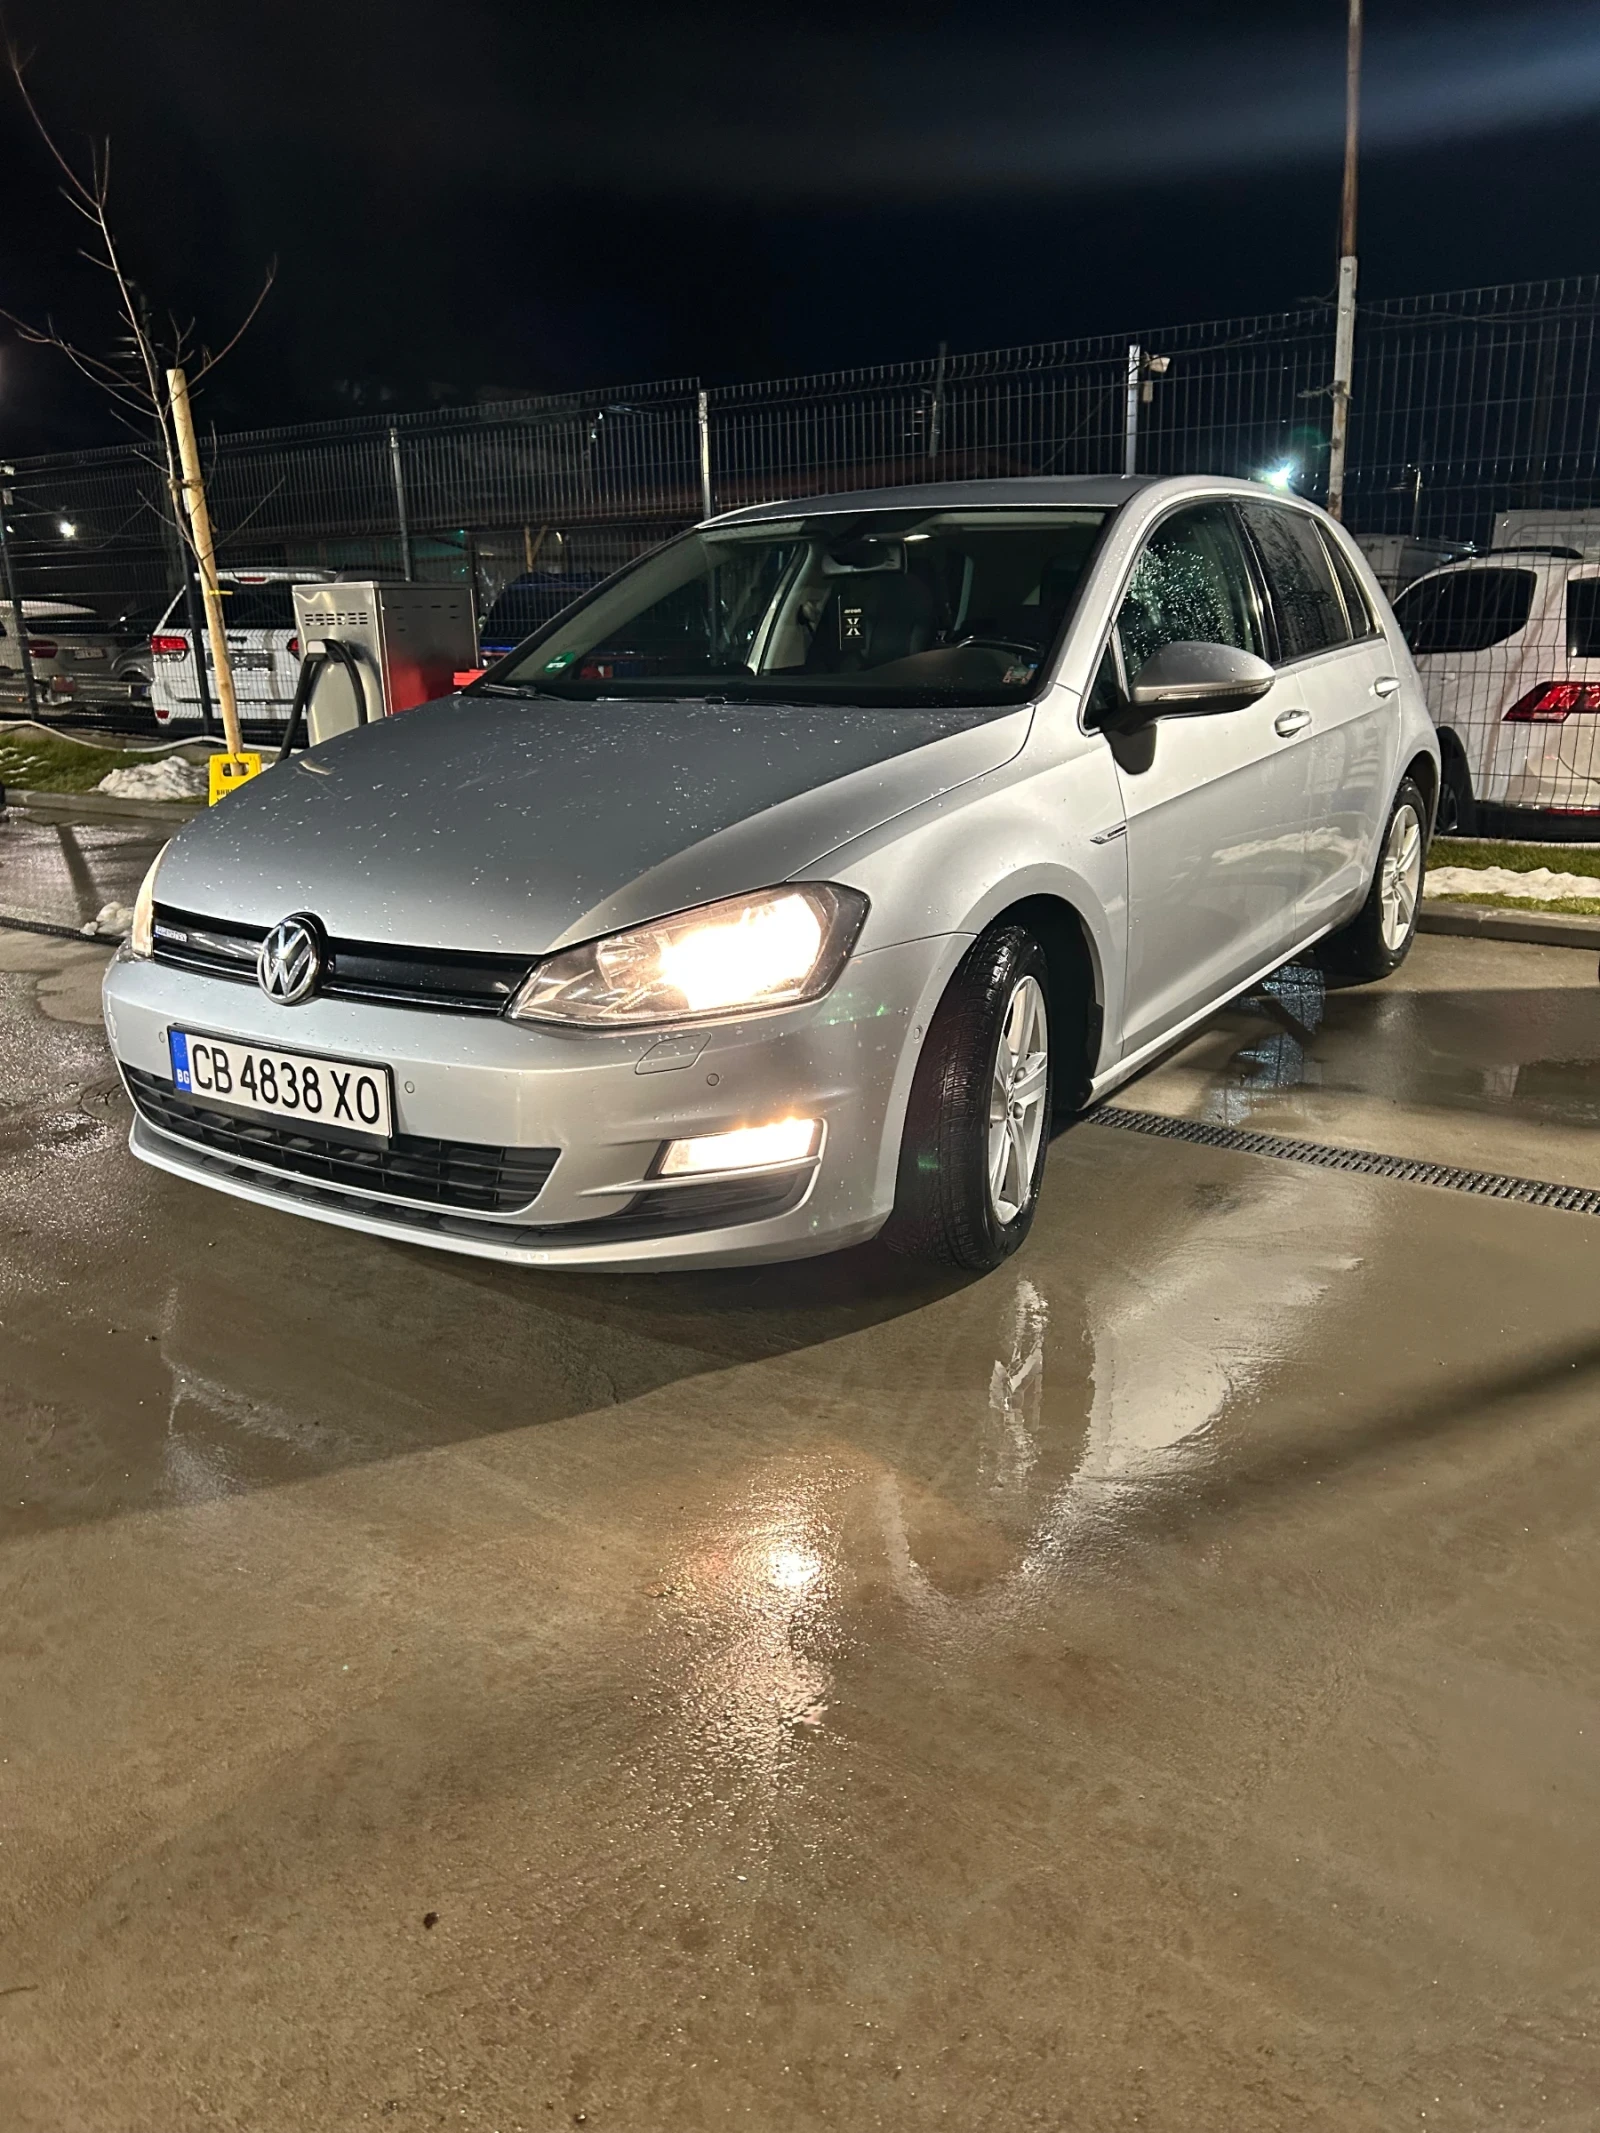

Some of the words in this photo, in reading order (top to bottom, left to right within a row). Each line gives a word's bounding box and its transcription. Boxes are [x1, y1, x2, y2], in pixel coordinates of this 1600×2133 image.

[176, 1068, 190, 1085] BG
[192, 1043, 233, 1094] CB
[240, 1054, 322, 1114] 4838
[329, 1070, 381, 1125] XO
